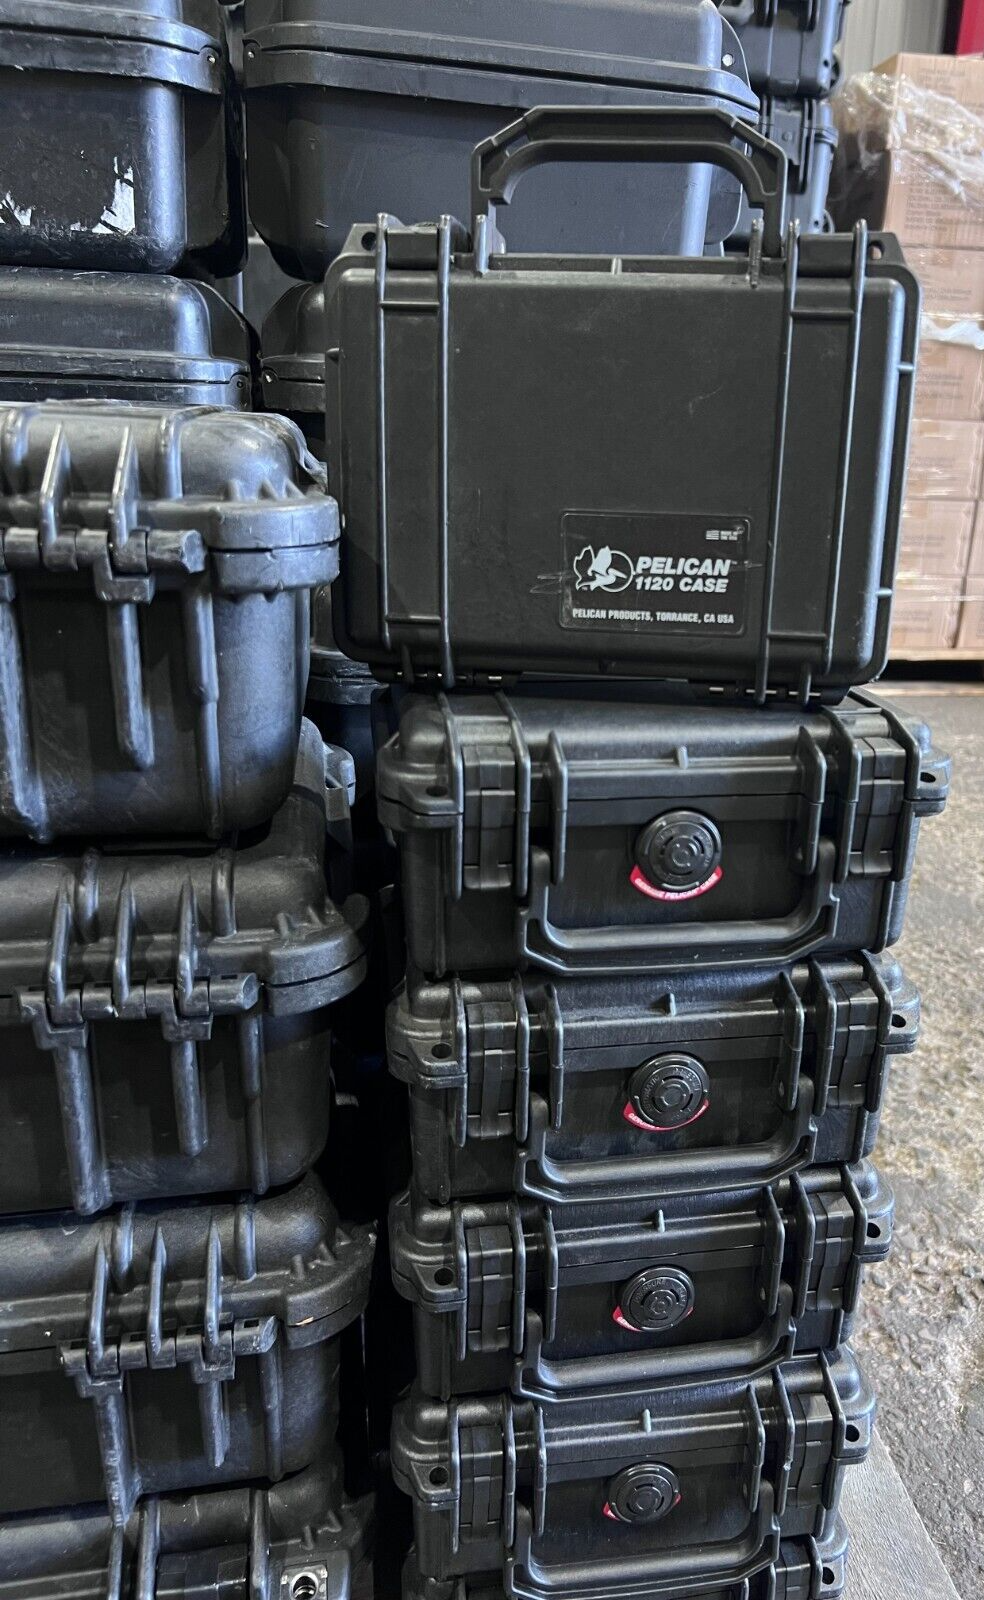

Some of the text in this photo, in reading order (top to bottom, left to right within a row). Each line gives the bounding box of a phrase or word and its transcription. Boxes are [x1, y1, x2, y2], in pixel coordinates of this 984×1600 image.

[636, 556, 731, 576] PELICAN
[635, 577, 729, 593] 1120 CASE
[572, 608, 735, 624] PELICAN PRODUCTS, TORRANCE, CA USA
